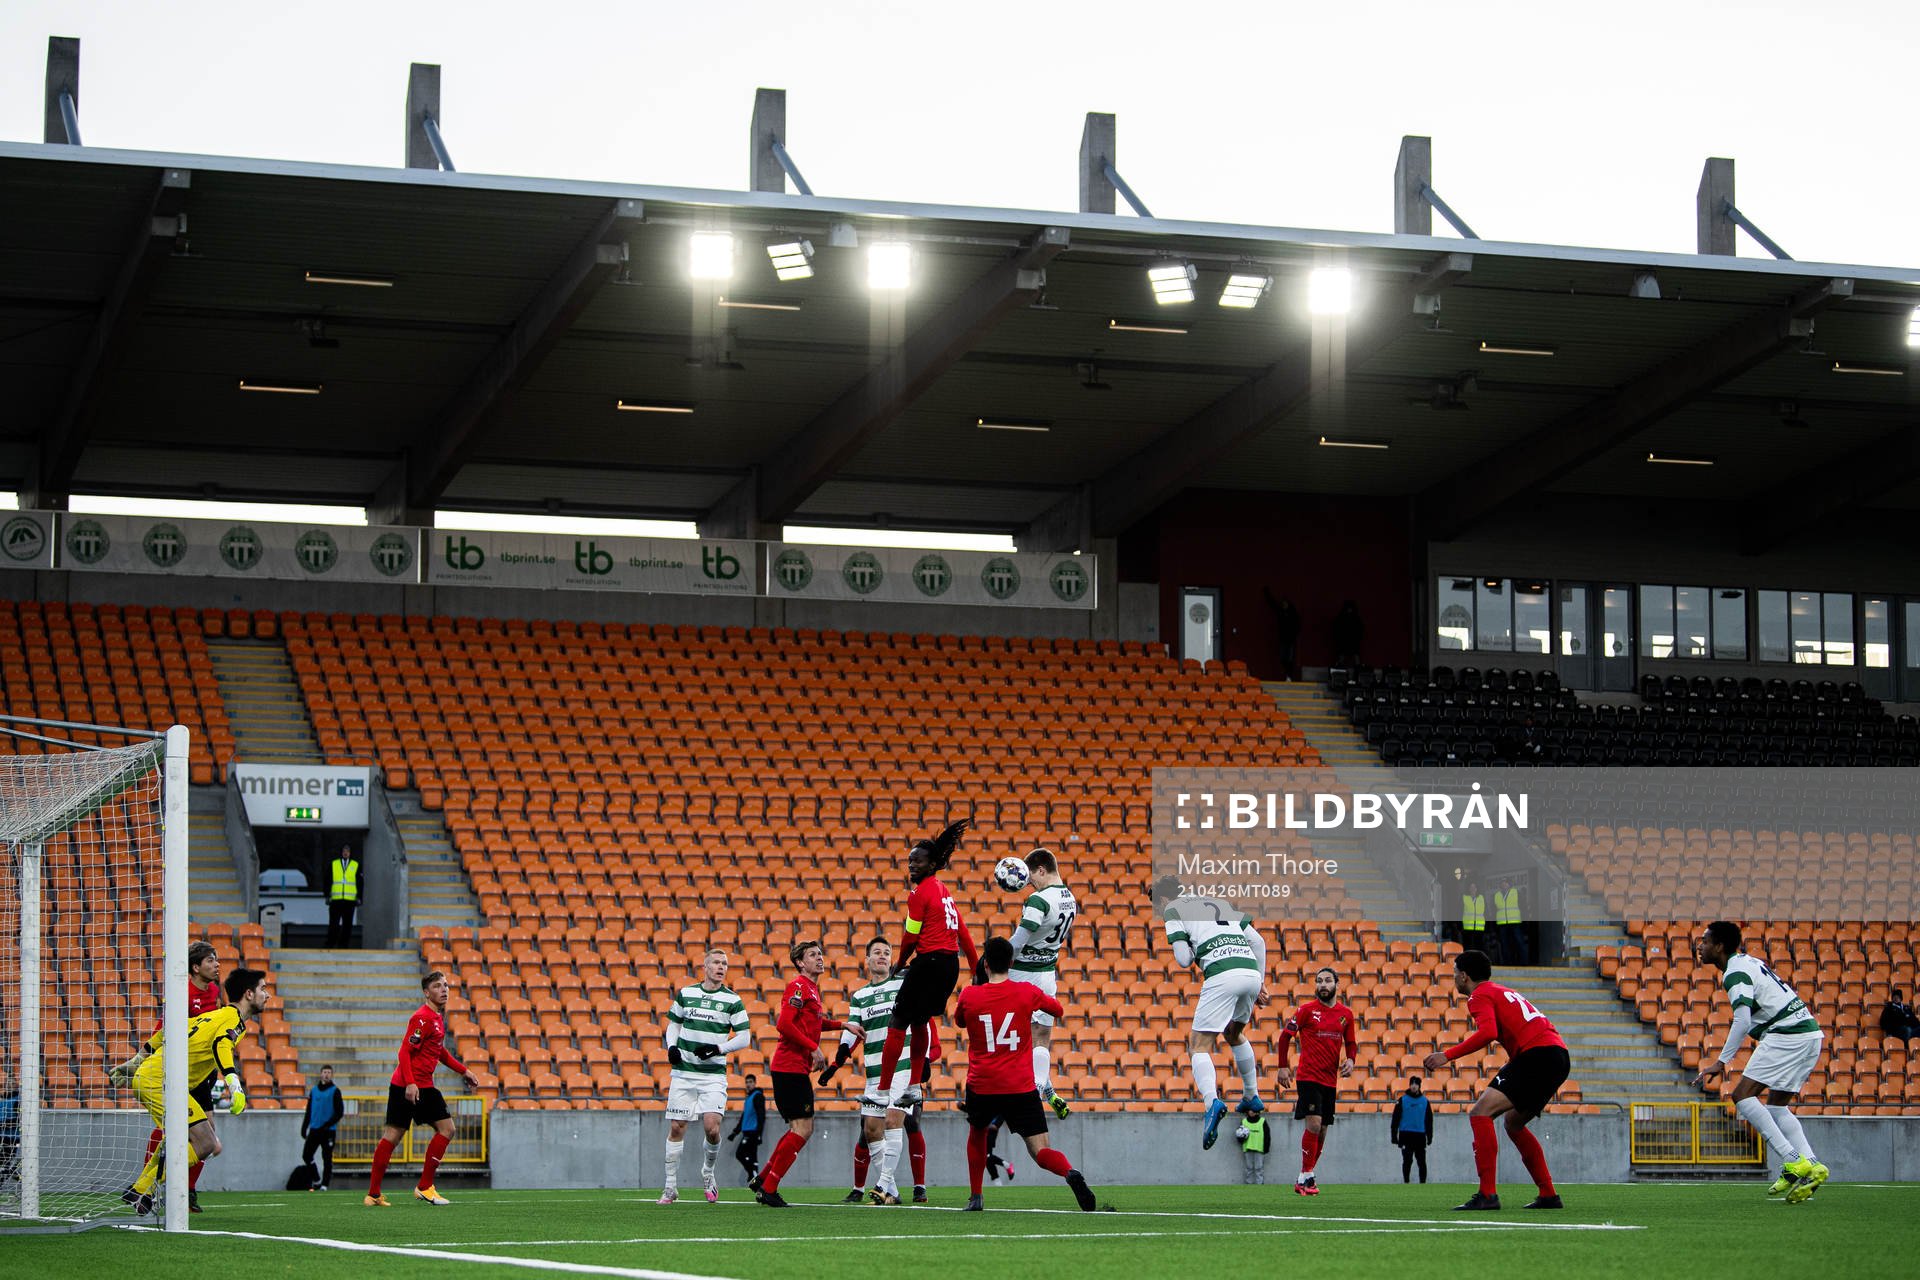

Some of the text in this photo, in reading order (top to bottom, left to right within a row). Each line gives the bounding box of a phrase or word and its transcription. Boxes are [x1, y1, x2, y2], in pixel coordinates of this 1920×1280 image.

[446, 536, 485, 570] tb
[500, 552, 556, 564] tbprint.se
[575, 541, 614, 575] tb
[629, 557, 684, 569] tbprint.se
[702, 546, 740, 580] tb
[241, 776, 334, 795] mimer
[978, 1012, 1020, 1053] 14
